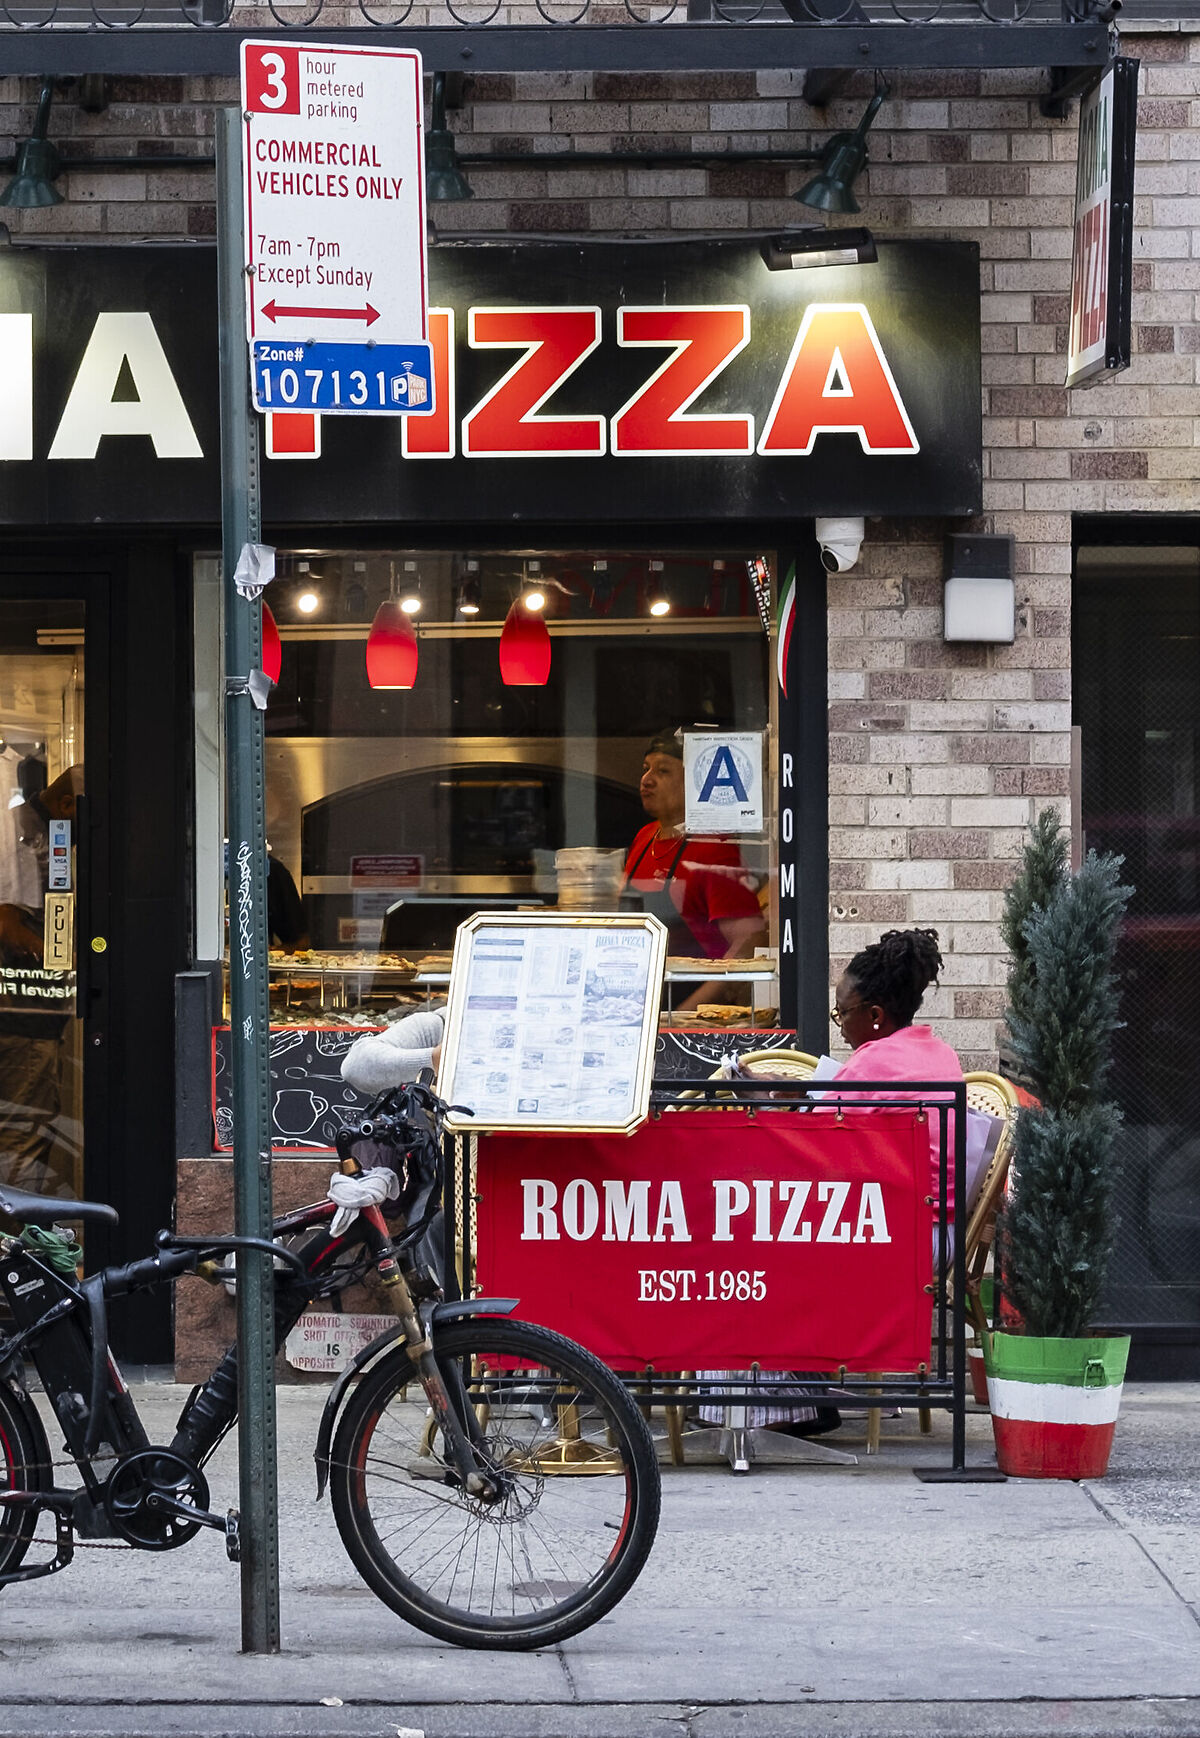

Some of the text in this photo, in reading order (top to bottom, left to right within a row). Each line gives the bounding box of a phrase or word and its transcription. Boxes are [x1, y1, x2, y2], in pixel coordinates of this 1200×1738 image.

[259, 52, 288, 109] 3
[306, 57, 336, 75] hour
[307, 80, 364, 98] metered
[307, 101, 357, 122] parking
[256, 138, 382, 168] COMMERCIAL
[257, 171, 403, 200] VEHICLES ONLY
[258, 235, 292, 256] 7am
[307, 237, 340, 261] 7pm
[258, 263, 373, 292] Except Sunday
[259, 346, 304, 362] Zone#
[261, 368, 386, 406] 107131
[265, 303, 921, 460] IZZA
[697, 745, 749, 802] A
[781, 752, 795, 954] ROMA
[54, 904, 64, 958] PULL
[520, 1178, 892, 1244] ROMA PIZZA
[637, 1269, 767, 1302] EST.1985
[295, 1316, 341, 1328] UTOMATIC
[292, 1356, 336, 1369] OPPOSITE
[326, 1343, 341, 1356] 16
